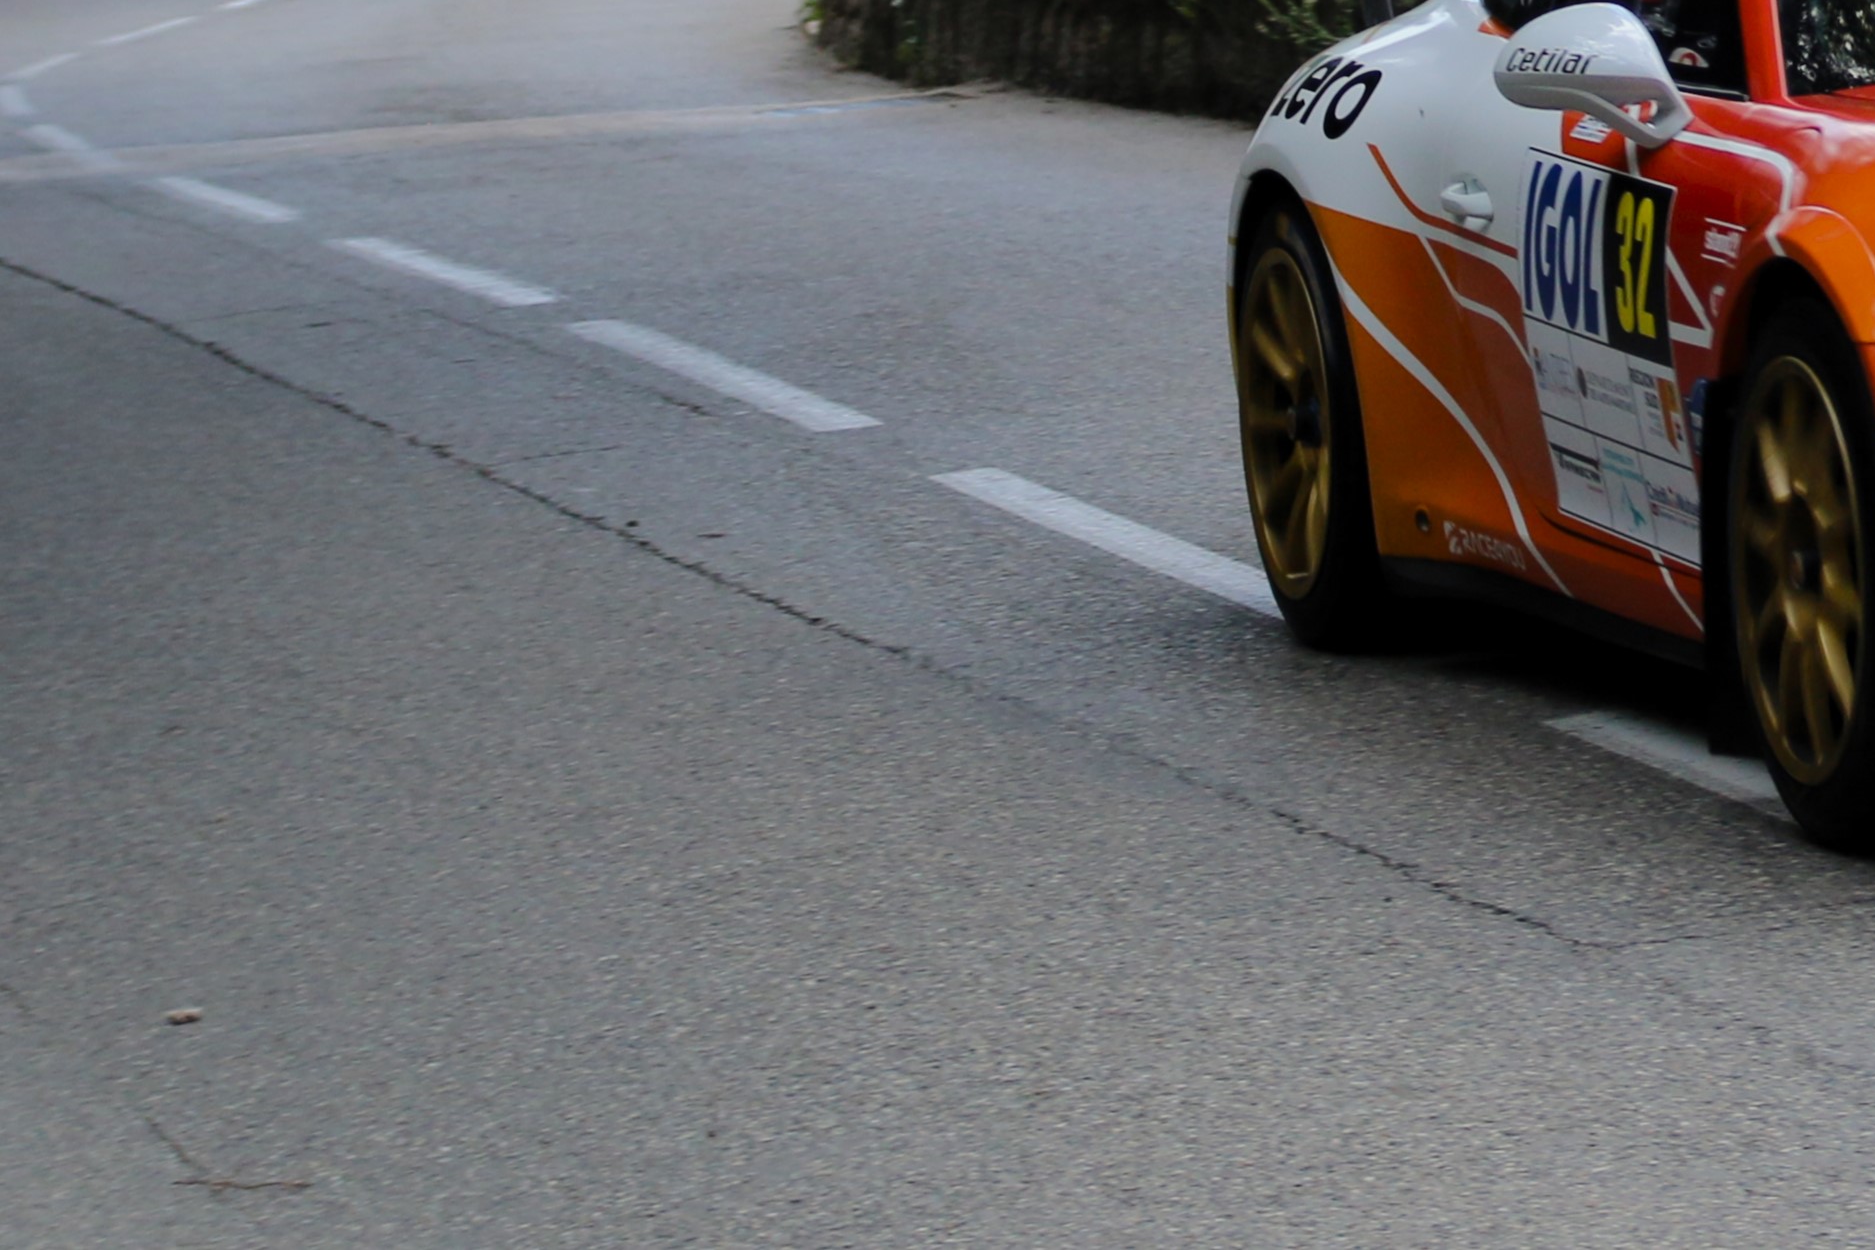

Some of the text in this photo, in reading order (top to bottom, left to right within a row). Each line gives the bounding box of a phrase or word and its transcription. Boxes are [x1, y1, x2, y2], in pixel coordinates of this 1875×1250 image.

[1505, 47, 1598, 75] Cetilar
[1524, 160, 1657, 338] IGOL 32
